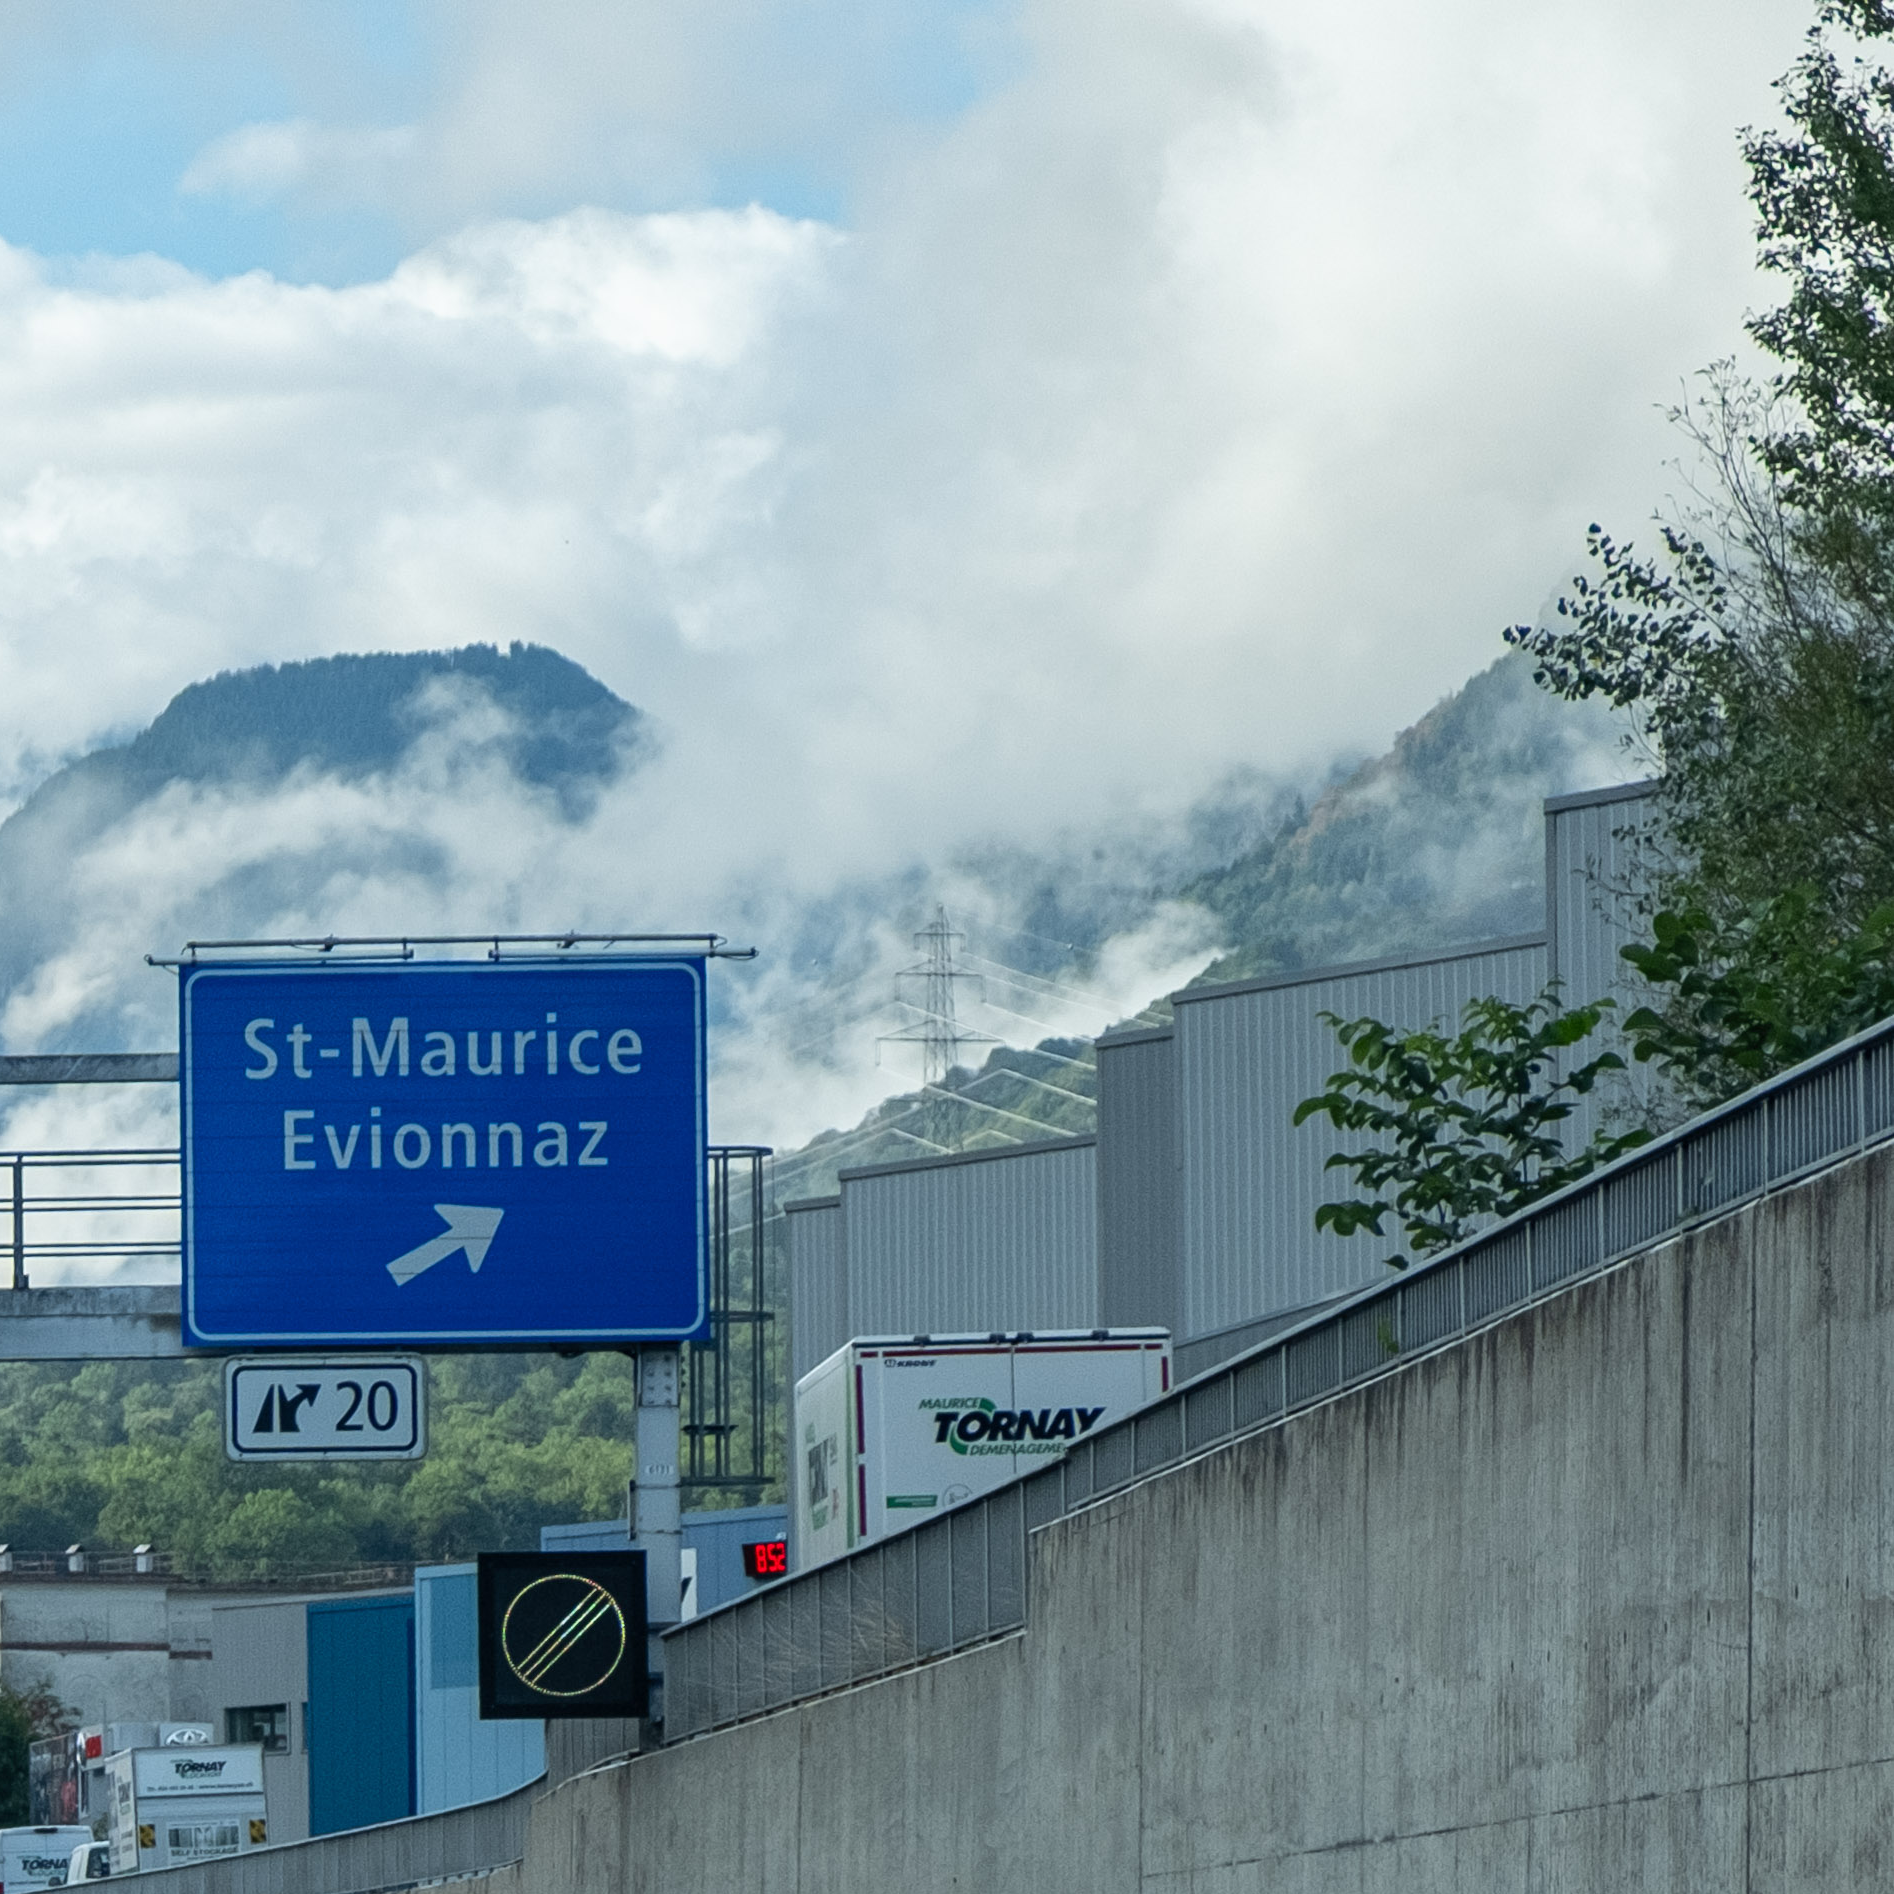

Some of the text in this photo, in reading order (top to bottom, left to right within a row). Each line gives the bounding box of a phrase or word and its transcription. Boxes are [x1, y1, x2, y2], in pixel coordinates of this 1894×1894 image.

[244, 1012, 643, 1080] St-Maurice
[283, 1106, 609, 1170] Evionnaz
[335, 1380, 399, 1432] 20
[918, 1397, 980, 1410] MAURICE
[934, 1406, 1107, 1443] TORNAY
[175, 1761, 227, 1774] TORNAY
